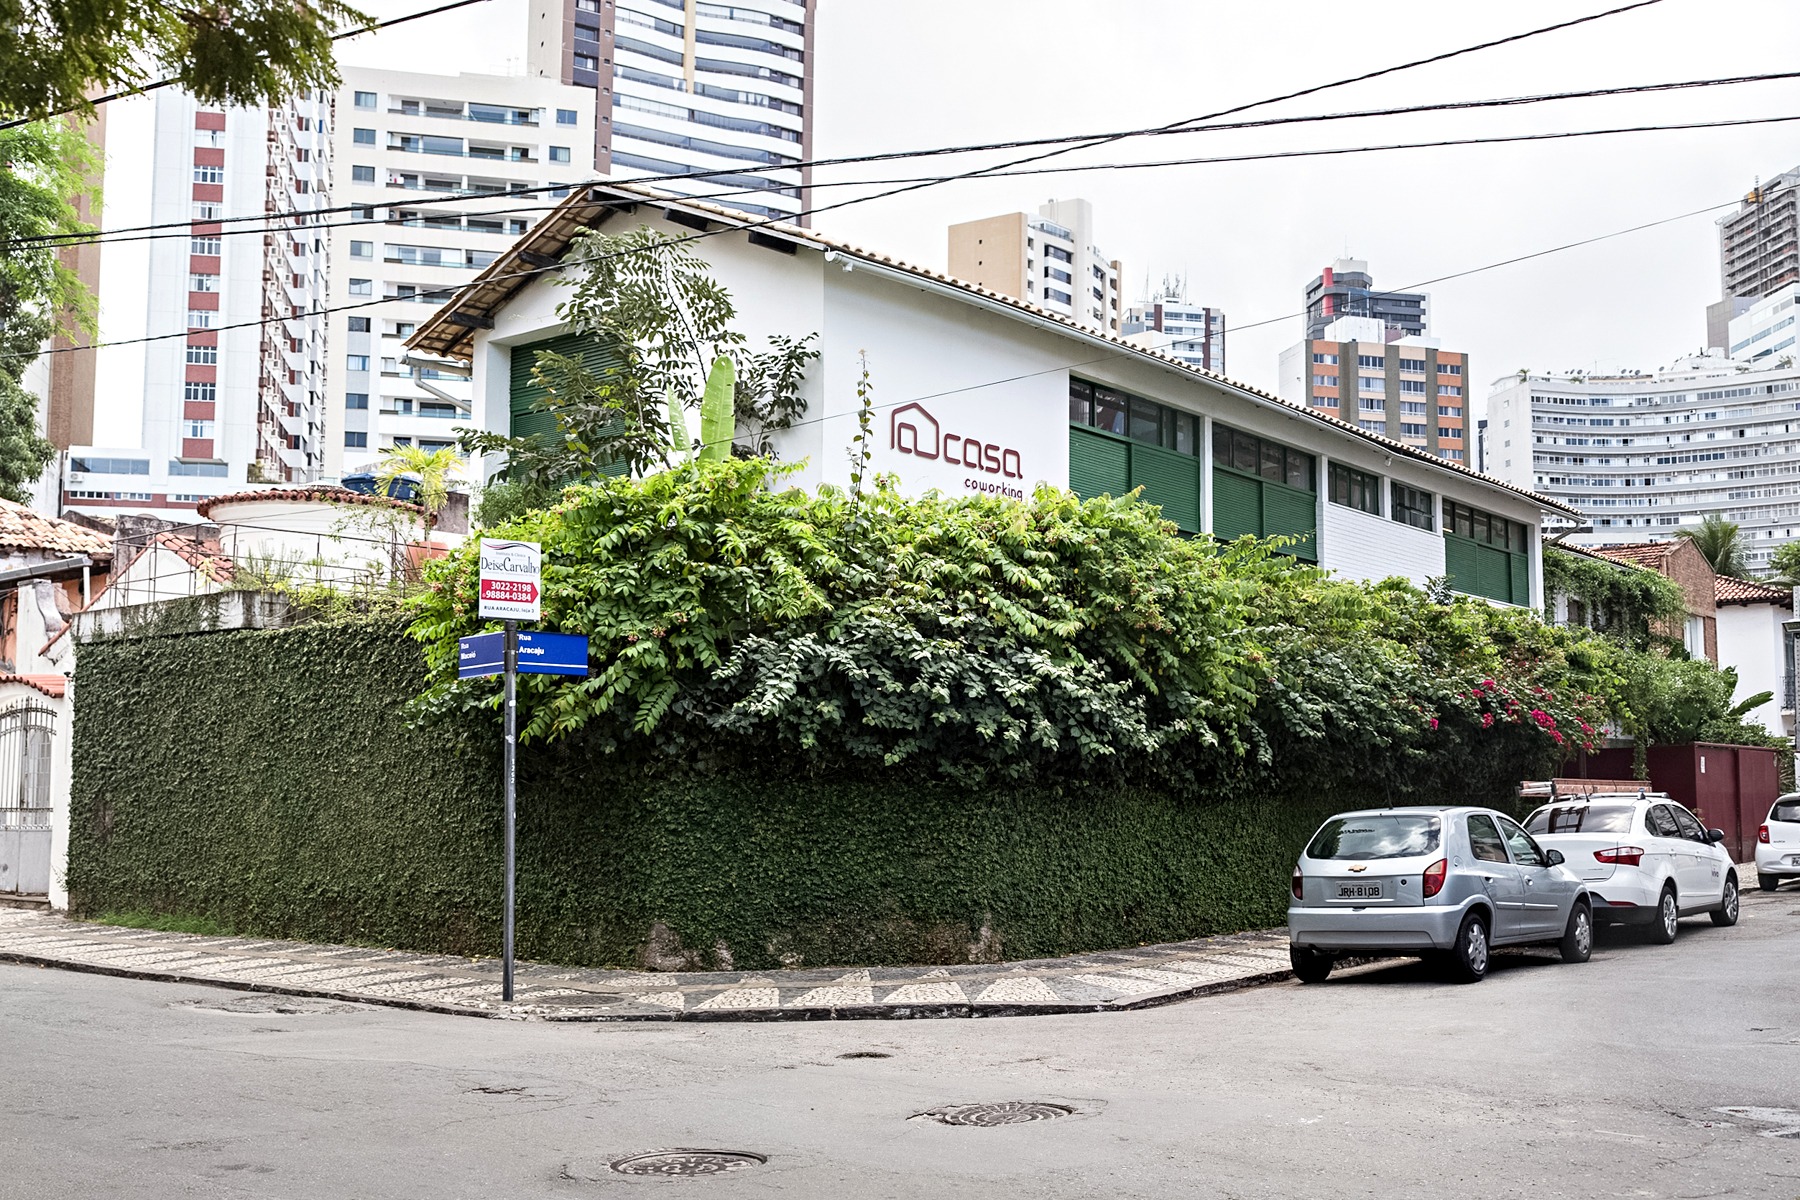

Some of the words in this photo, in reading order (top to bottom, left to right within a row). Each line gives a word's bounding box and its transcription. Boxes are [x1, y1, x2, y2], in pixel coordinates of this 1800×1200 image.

[964, 477, 1024, 502] coworking
[491, 581, 532, 592] 3022-2198
[486, 590, 532, 601] 98884-0384
[460, 642, 469, 650] Rua
[519, 646, 544, 655] Aracaju
